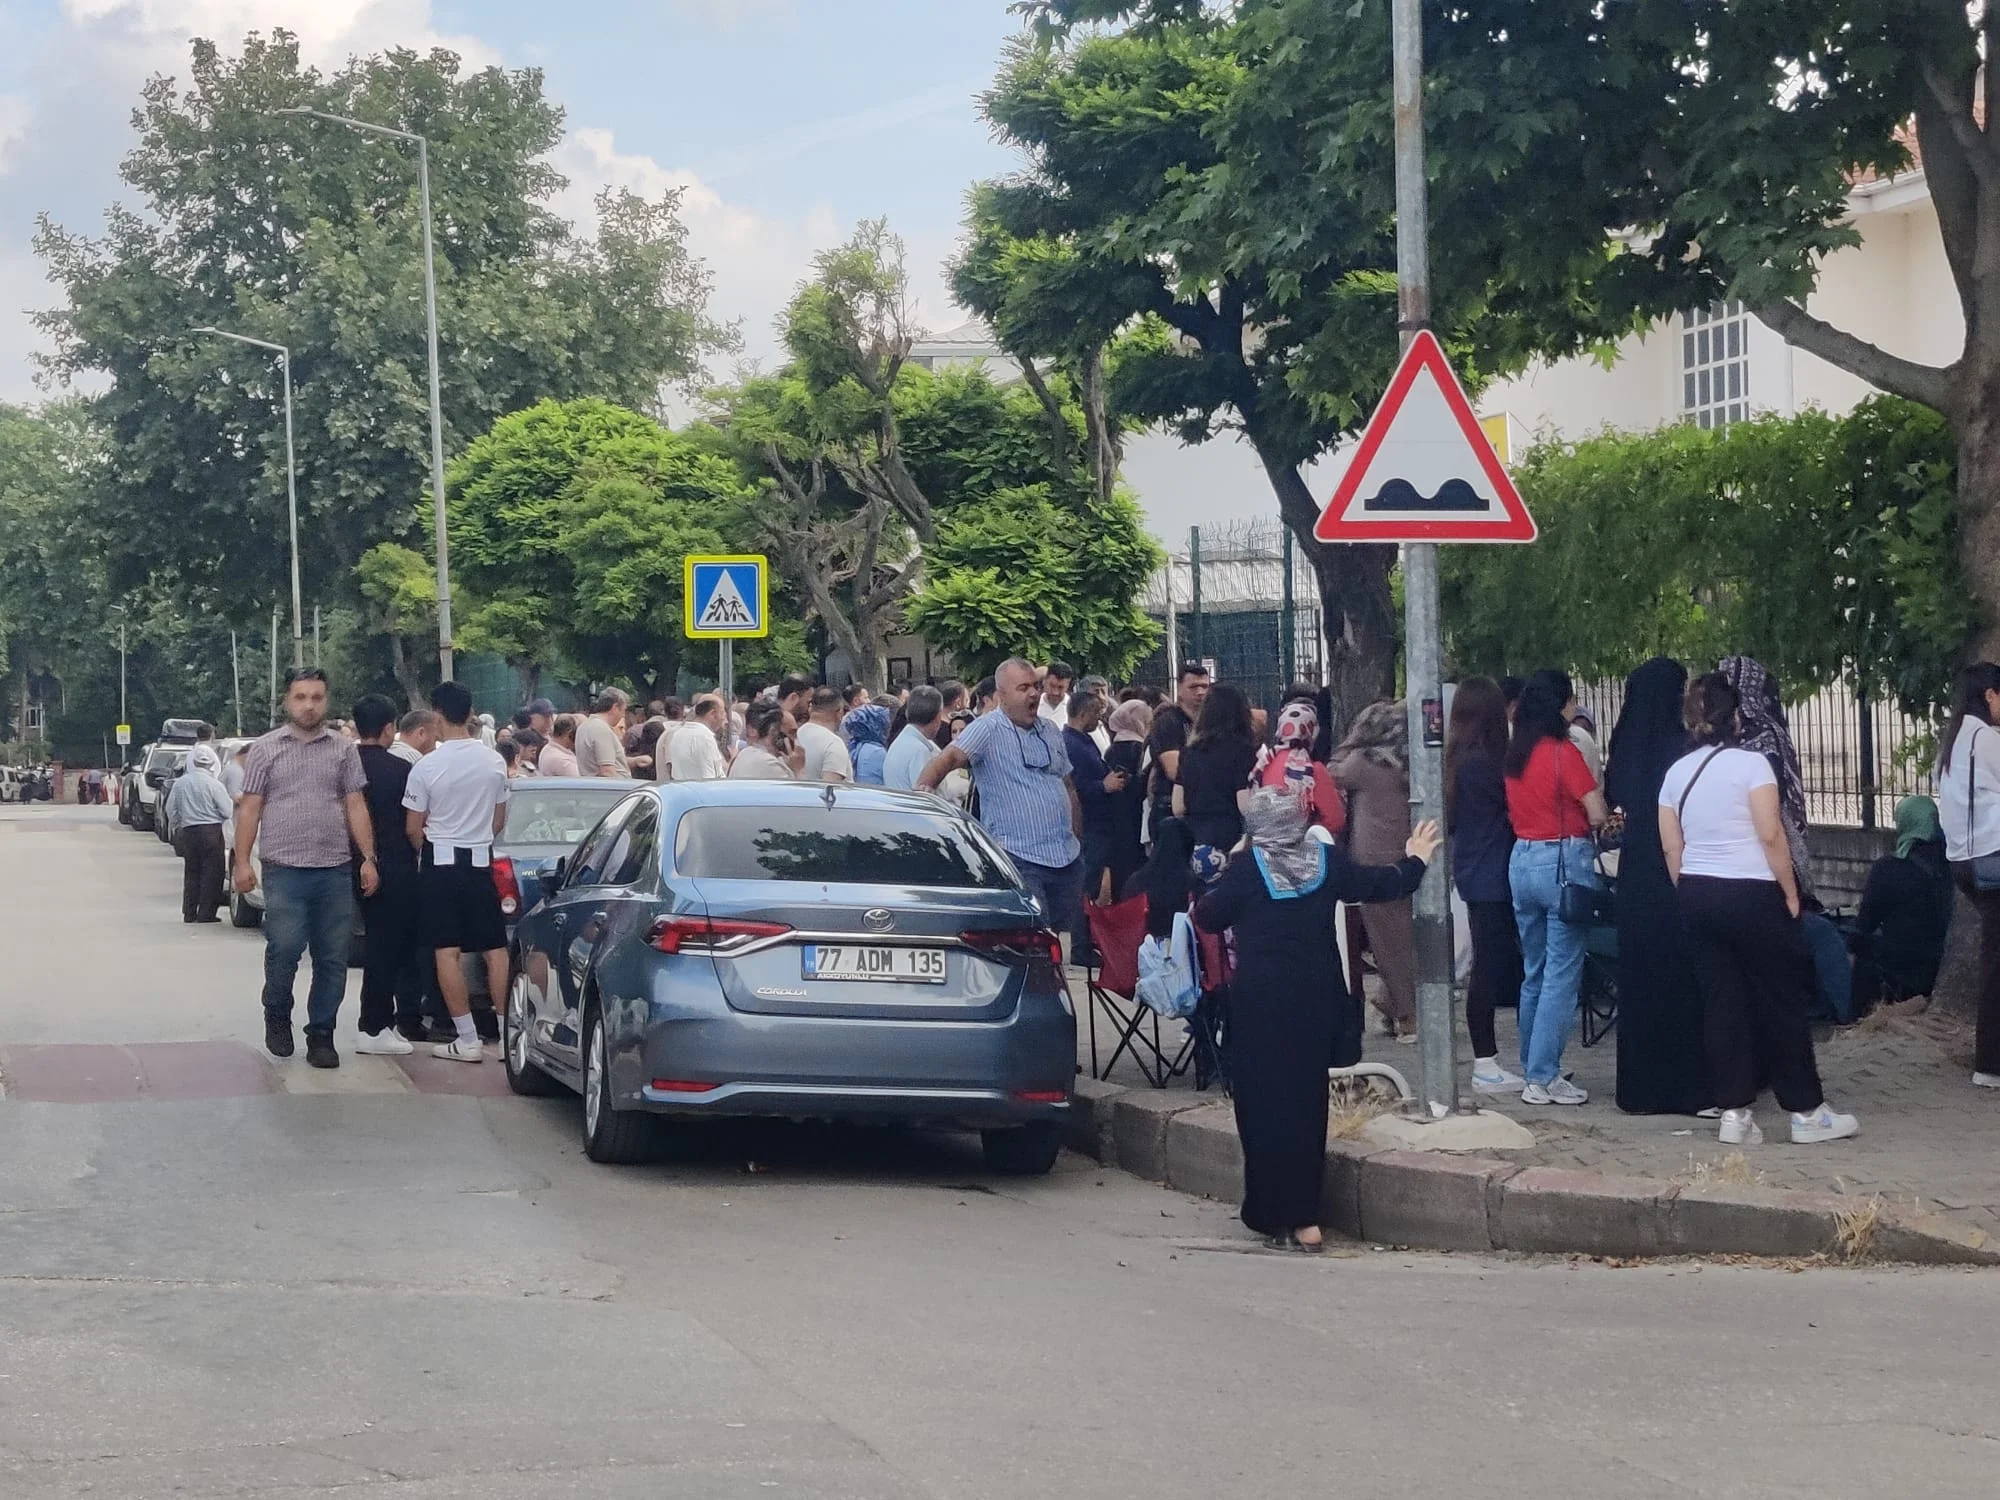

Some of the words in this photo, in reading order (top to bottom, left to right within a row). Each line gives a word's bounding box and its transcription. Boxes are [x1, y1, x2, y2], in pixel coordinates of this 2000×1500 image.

[817, 948, 842, 971] 77
[856, 949, 893, 973] ADM
[908, 951, 943, 974] 135
